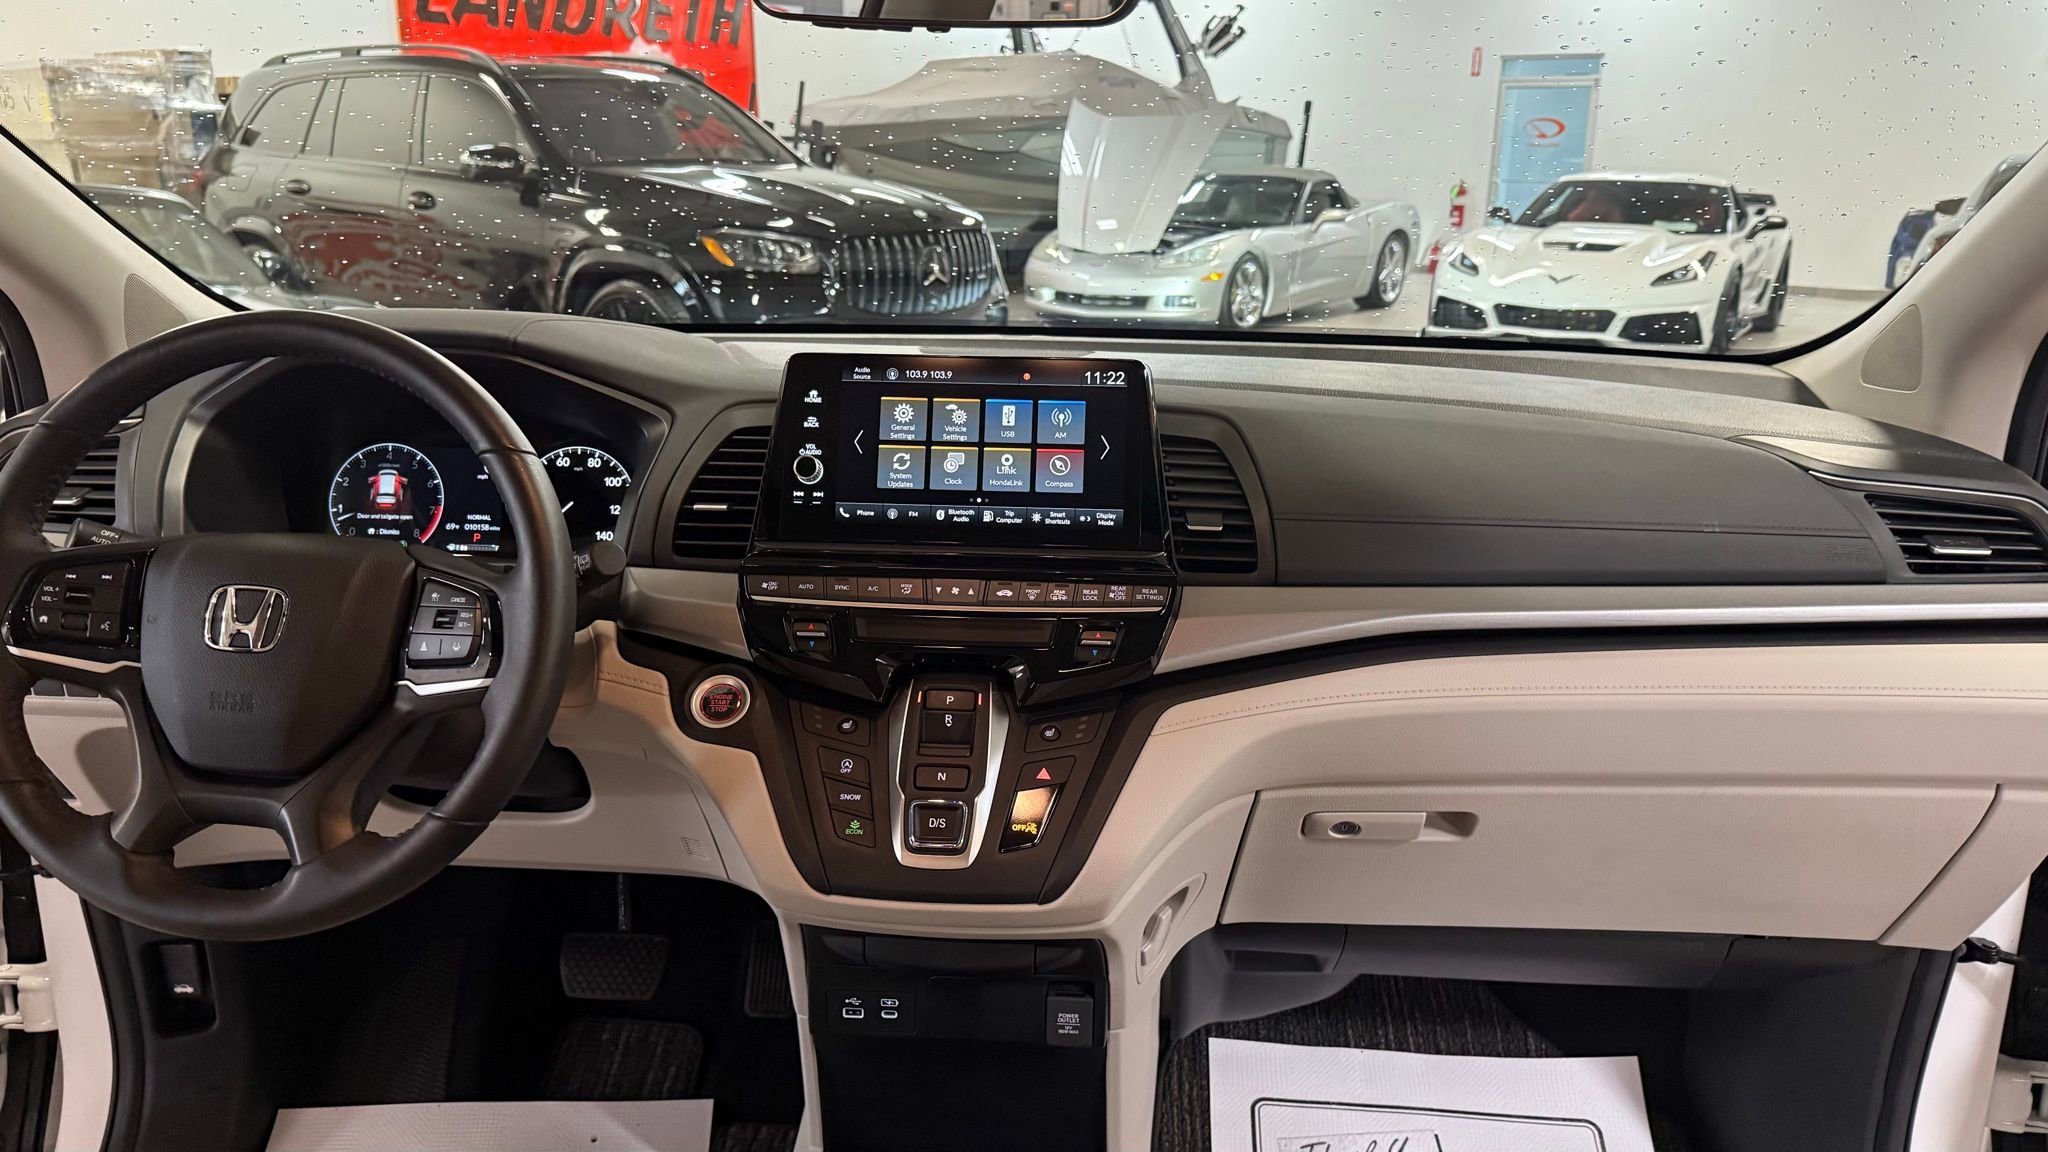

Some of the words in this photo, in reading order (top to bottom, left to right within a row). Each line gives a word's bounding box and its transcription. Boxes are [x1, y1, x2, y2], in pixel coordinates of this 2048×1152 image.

[906, 370, 927, 379] 103.9
[931, 371, 952, 379] 103.9
[1084, 371, 1125, 385] 11:22
[942, 433, 967, 441] Settings
[360, 460, 367, 468] 3
[412, 461, 418, 469] 5
[556, 457, 570, 467] 60
[587, 458, 601, 468] 80
[889, 472, 912, 480] System
[342, 477, 349, 487] 2
[427, 480, 434, 488] 6
[604, 477, 621, 487] 100
[887, 481, 913, 489] Updates
[1045, 480, 1073, 488] Compass
[338, 504, 343, 513] 1
[429, 506, 435, 515] 7
[609, 505, 621, 515] 12
[1096, 512, 1117, 520] Display
[349, 527, 355, 536] 0
[464, 523, 490, 531] 010158
[101, 530, 115, 538] OFF
[414, 529, 420, 538] 8
[473, 533, 481, 543] P
[595, 531, 613, 541] 140
[946, 695, 954, 705] P
[945, 714, 953, 724] R
[937, 772, 947, 781] N
[839, 793, 861, 801] SNOW
[928, 817, 946, 828] D/S
[1011, 823, 1026, 832] OFF
